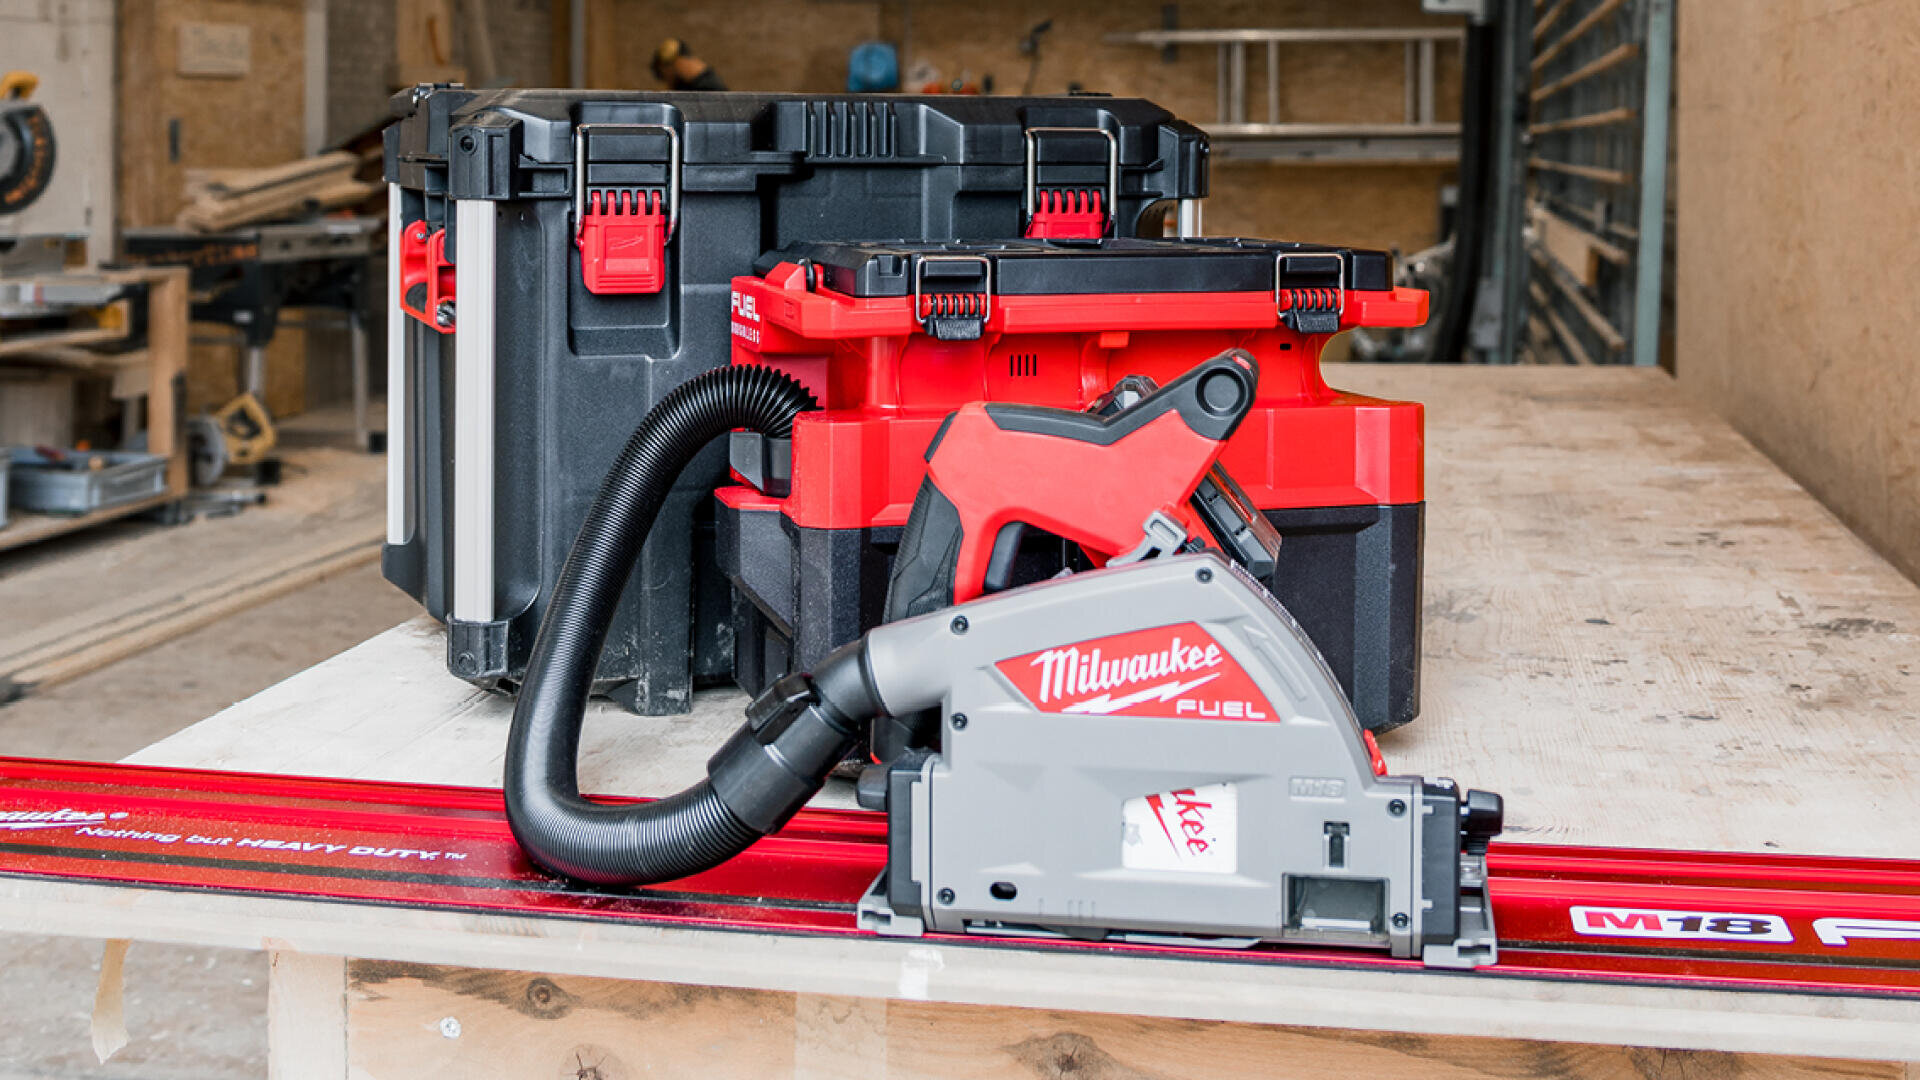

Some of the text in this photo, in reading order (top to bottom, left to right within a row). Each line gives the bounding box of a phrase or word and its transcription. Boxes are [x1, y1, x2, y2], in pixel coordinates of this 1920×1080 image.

[731, 291, 760, 322] FUEL
[1030, 637, 1223, 703] Milwaukee
[1176, 699, 1266, 719] FUEL
[75, 827, 182, 843] Nothing
[185, 835, 233, 845] but
[236, 838, 347, 853] HEAVY
[1584, 911, 1772, 935] M18
